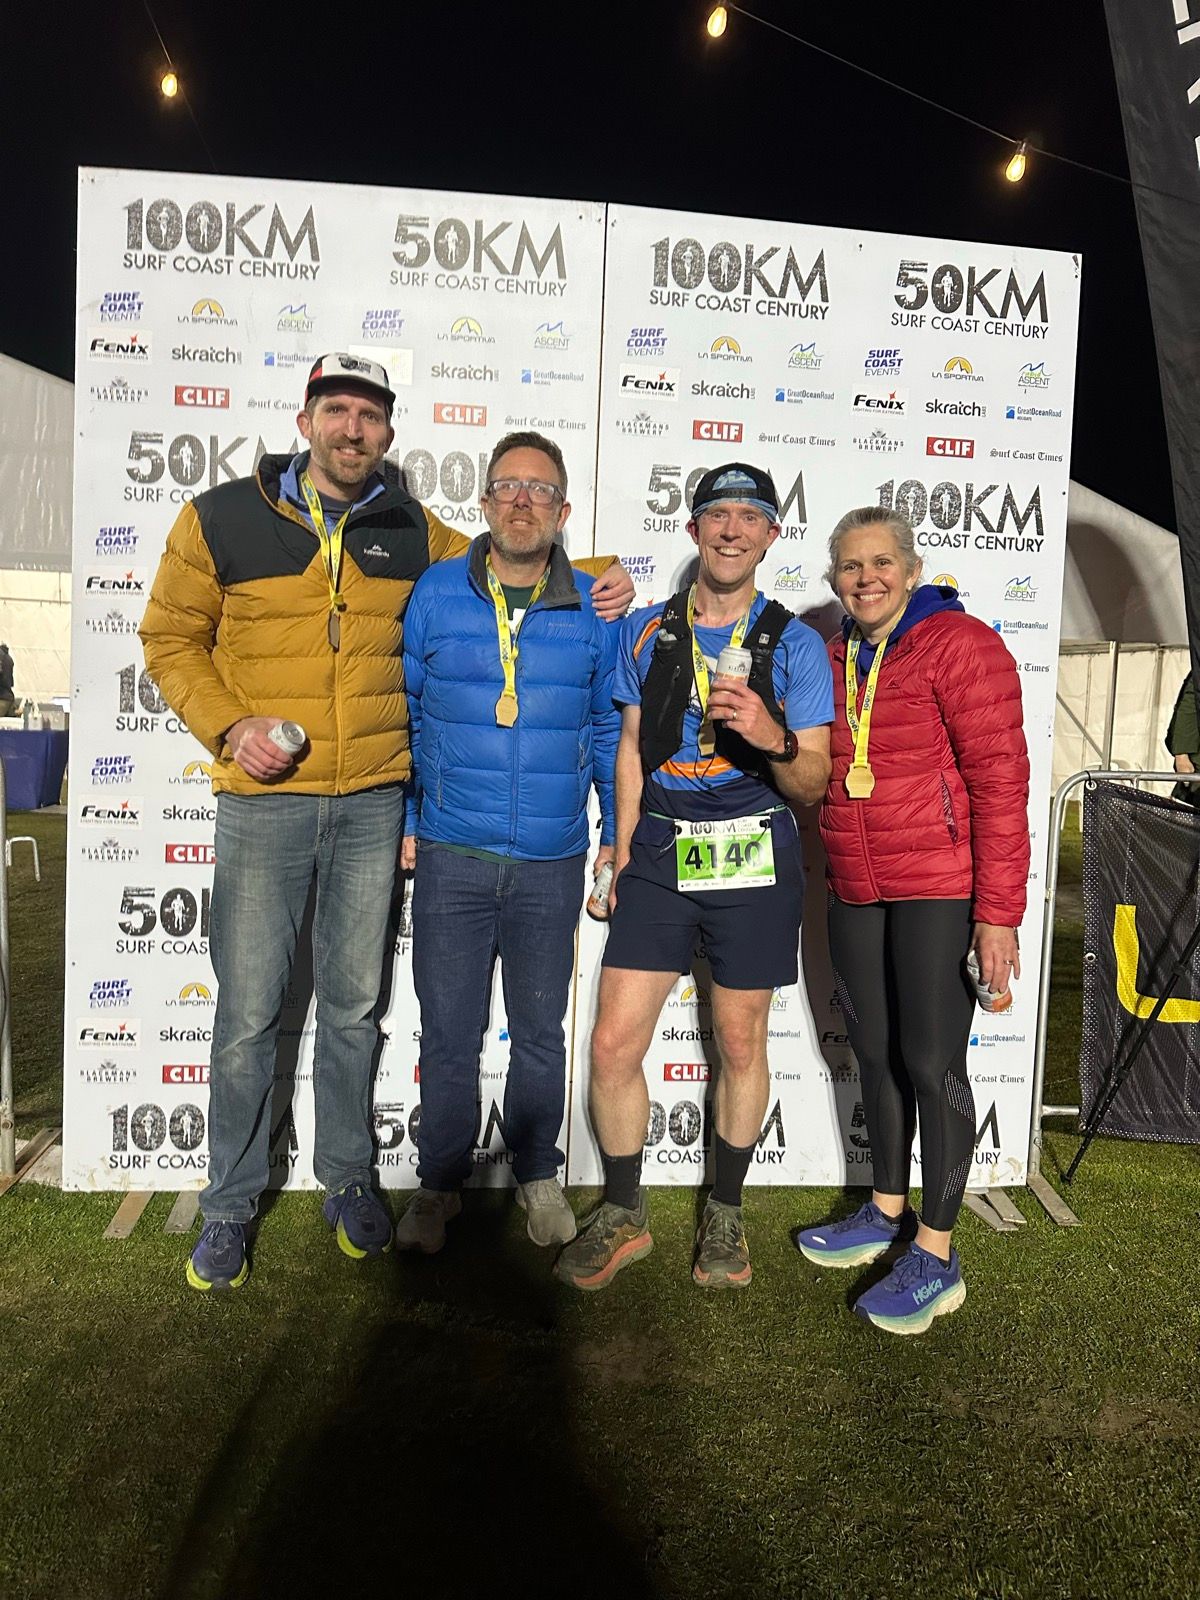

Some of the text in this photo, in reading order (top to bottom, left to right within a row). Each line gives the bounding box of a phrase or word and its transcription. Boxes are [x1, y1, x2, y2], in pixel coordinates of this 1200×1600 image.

[122, 198, 320, 262] 100KM
[393, 214, 567, 280] 50KM
[123, 252, 320, 280] SURF COAST CENTURY
[650, 236, 829, 303] 100KM
[390, 271, 567, 297] SURF COAST CENTURY
[104, 292, 140, 301] SURF
[894, 260, 1048, 322] 50KM
[100, 302, 144, 312] COAST
[650, 289, 829, 320] SURF COAST CENTURY
[101, 312, 141, 322] EVENTS
[366, 310, 401, 320] SURF
[192, 316, 238, 326] SPORTIVA
[362, 320, 404, 330] COAST
[891, 312, 1048, 340] SURF COAST CENTURY
[362, 330, 401, 338] EVENTS
[630, 328, 664, 338] SURF
[450, 334, 496, 344] SPORTIVA
[534, 336, 570, 348] ASCENT
[627, 337, 668, 347] COAST
[172, 344, 236, 364] skratch
[627, 346, 664, 356] EVENTS
[868, 349, 900, 358] SURF
[710, 354, 752, 363] SPORTIVA
[788, 357, 822, 368] ASCENT
[864, 358, 903, 368] COAST
[431, 362, 493, 382] skratch
[864, 368, 900, 376] EVENTS
[944, 373, 984, 382] SPORTIVA
[1018, 376, 1050, 386] ASCENT
[692, 380, 750, 400] skratch
[787, 388, 834, 400] GreatOceanRoad
[182, 388, 226, 406] CLIF
[248, 398, 300, 410] Surf Coast
[926, 399, 981, 416] skratch
[440, 406, 484, 424] CLIF
[1018, 406, 1062, 418] GreatOceanRoad
[504, 416, 587, 430] Surf Coast Times
[616, 420, 669, 430] BLACKMANS
[622, 428, 662, 436] BREWERY
[700, 422, 740, 441] CLIF
[758, 432, 836, 447] Surf Coast Times
[852, 438, 904, 447] BLACKMANS
[858, 444, 898, 452] BREWERY
[932, 440, 971, 456] CLIF
[990, 448, 1064, 462] Surf Coast Times
[124, 486, 164, 502] SURF
[874, 478, 1044, 536] 100KM
[643, 518, 680, 532] SURF
[99, 526, 136, 536] SURF
[96, 536, 139, 546] COAST
[918, 532, 1045, 553] COAST CENTURY
[96, 546, 136, 556] EVENTS
[620, 556, 652, 566] SURF
[774, 580, 808, 588] ASCENT
[1004, 590, 1037, 598] ASCENT
[1003, 620, 1048, 630] GreatOceanRoad
[1024, 662, 1050, 672] Times
[116, 716, 159, 733] SURF
[94, 756, 132, 766] SURF
[91, 766, 135, 776] COAST
[92, 776, 132, 786] EVENTS
[162, 805, 216, 821] skratc
[81, 848, 140, 856] BLACKMANS
[685, 841, 764, 870] 4140
[88, 854, 133, 862] BREWERY
[116, 940, 208, 954] SURF COAS
[93, 979, 128, 990] SURF
[89, 988, 132, 1000] COAST
[90, 1000, 130, 1009] EVENTS
[160, 1026, 212, 1042] skratc
[980, 1034, 1026, 1042] GreatOceanRoad
[670, 1065, 709, 1080] CLIF
[774, 1071, 800, 1080] Times
[974, 1074, 1024, 1084] Coast Times
[109, 1154, 151, 1170] SURF
[376, 1152, 404, 1166] URF
[657, 1150, 710, 1164] COAST
[912, 1278, 943, 1306] HOKA
